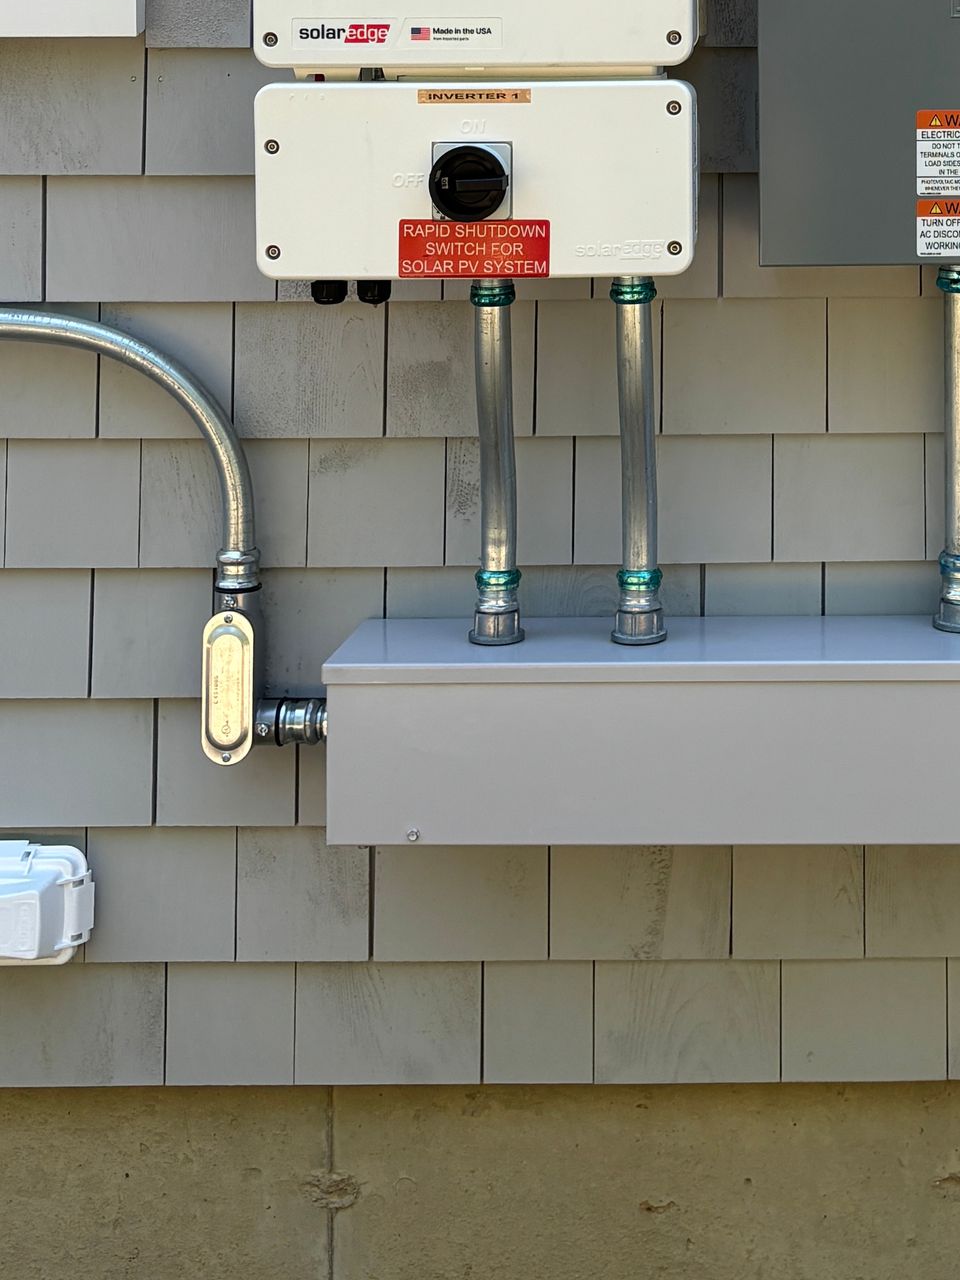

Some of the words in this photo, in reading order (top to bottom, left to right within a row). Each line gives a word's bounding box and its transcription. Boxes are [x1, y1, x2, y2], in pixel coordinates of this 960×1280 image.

[299, 24, 389, 43] solaredge
[433, 27, 453, 35] Made
[454, 27, 461, 35] in
[462, 27, 474, 35] the
[475, 27, 492, 35] USA
[428, 92, 506, 100] INVERTER
[510, 92, 519, 100] 1
[459, 119, 485, 133] ON
[921, 130, 960, 139] ELECTRIC
[392, 173, 425, 188] OFF
[922, 218, 943, 227] TURN
[403, 223, 451, 239] RAPID
[454, 223, 546, 239] SHUTDOWN
[920, 230, 931, 238] AC
[425, 242, 486, 256] SWITCH
[489, 242, 524, 256] FOR
[575, 240, 665, 260] solaredge
[402, 260, 454, 274] SOLAR
[458, 260, 479, 274] PV
[483, 260, 547, 274] SYSTEM
